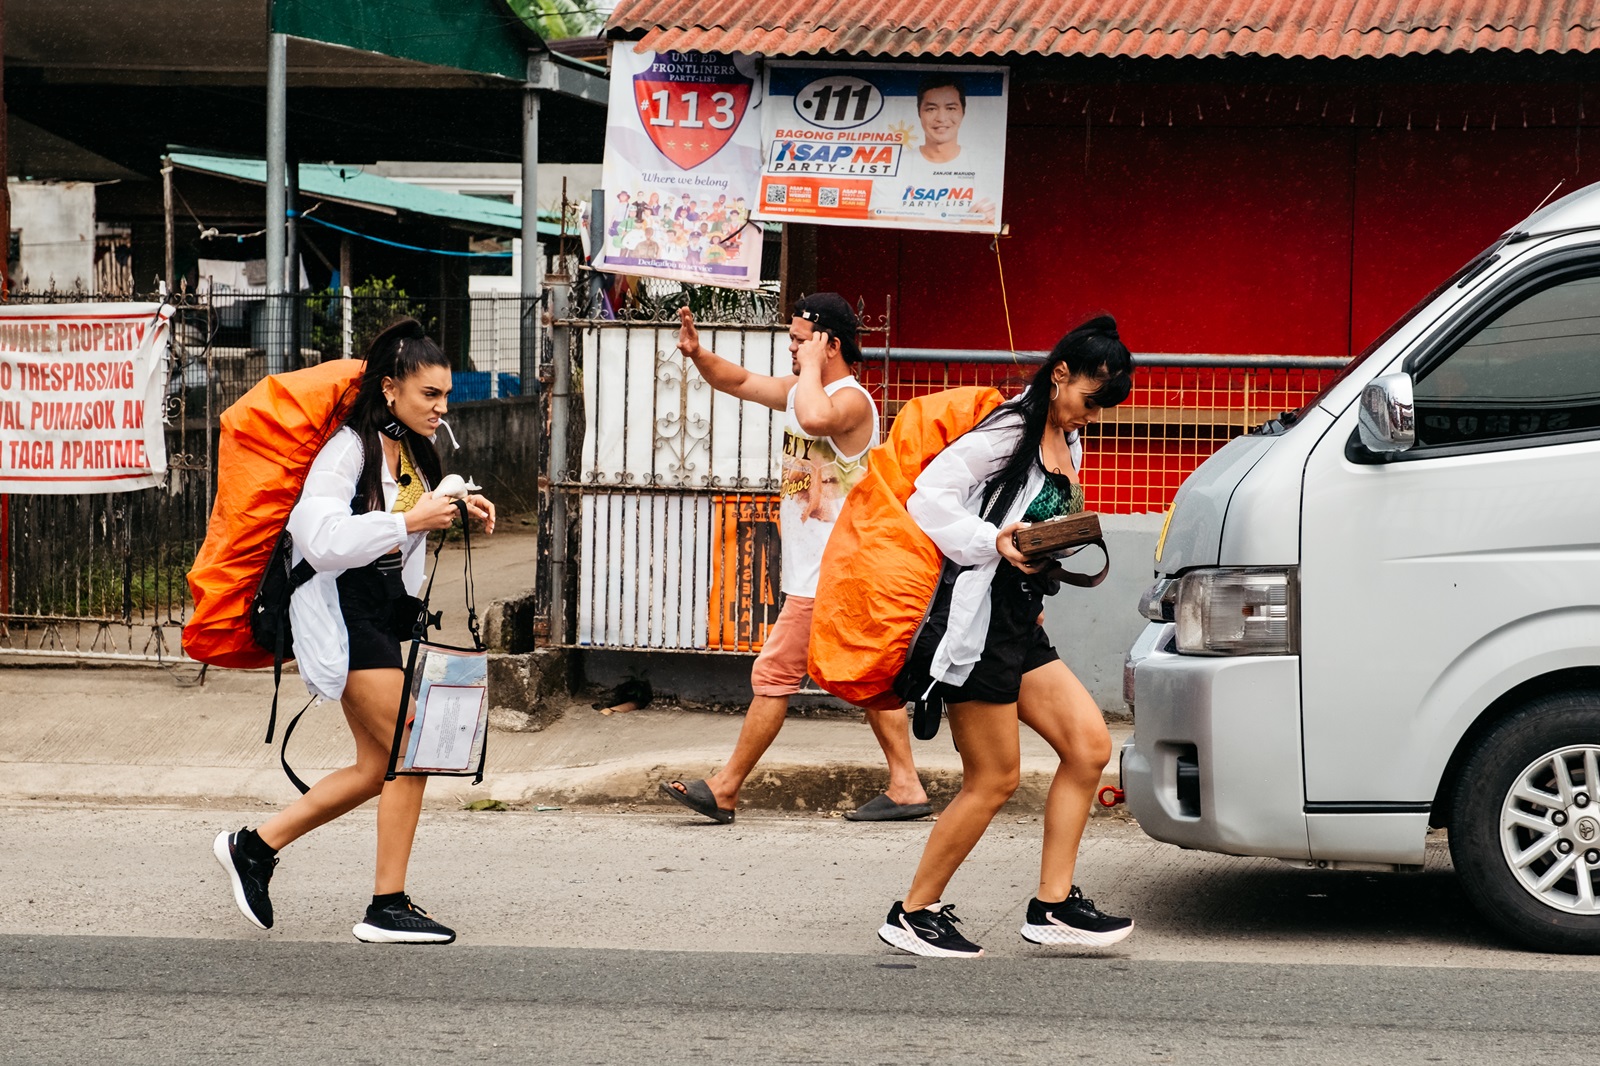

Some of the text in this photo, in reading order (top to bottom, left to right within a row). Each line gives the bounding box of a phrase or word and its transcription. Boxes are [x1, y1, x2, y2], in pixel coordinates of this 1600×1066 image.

[671, 52, 717, 63] UNIED
[652, 63, 735, 75] FRONTLINERS
[669, 74, 717, 83] PARTY-LIST
[775, 129, 903, 142] BAGONG PILIPINAS
[641, 172, 729, 189] Where we belong
[0, 322, 145, 352] IVATE PROPERTY
[17, 360, 134, 391] TRESPASSING
[31, 400, 116, 430] PUMASOK
[9, 441, 54, 469] TAGA
[60, 440, 150, 469] APARTME
